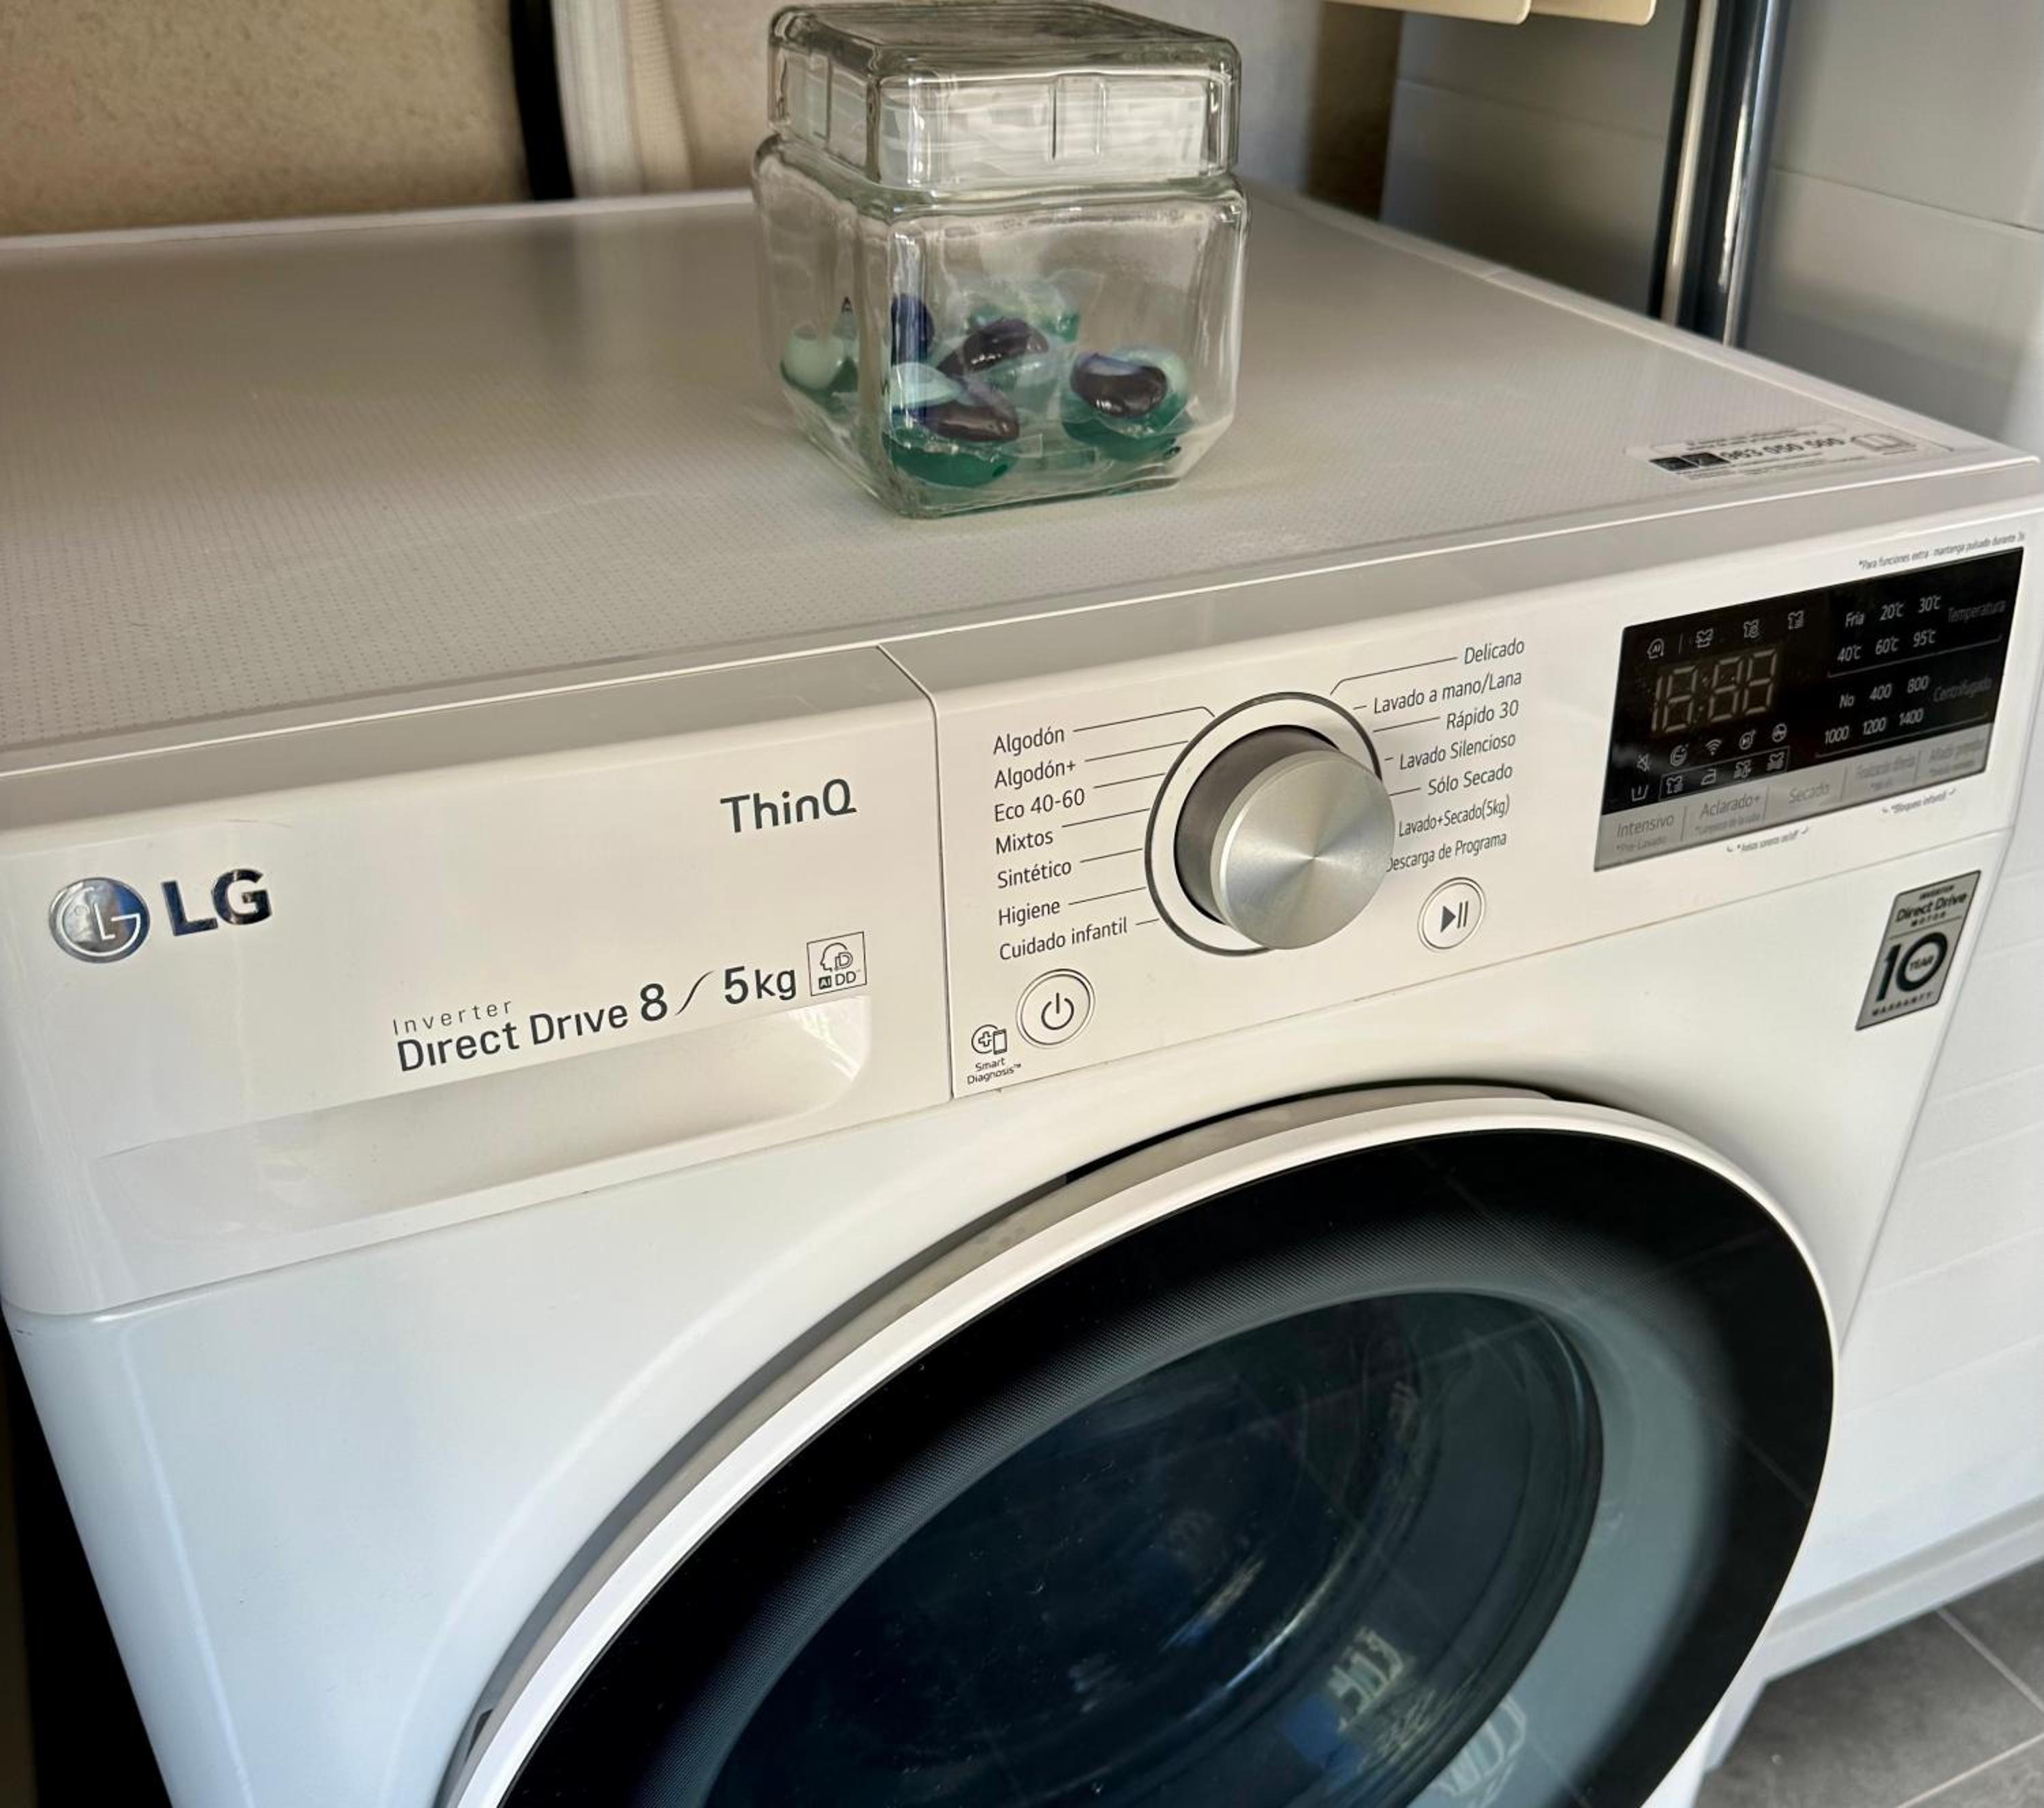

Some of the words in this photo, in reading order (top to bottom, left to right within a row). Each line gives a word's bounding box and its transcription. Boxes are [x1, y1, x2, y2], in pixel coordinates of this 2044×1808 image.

[1947, 599, 2007, 623] Temperatura
[1464, 638, 1524, 665] Delicado
[1374, 689, 1425, 715] Lavado
[1429, 689, 1438, 702] a
[1442, 671, 1521, 700] mano/Lana
[1839, 693, 1855, 709] No
[1869, 683, 1893, 701] 400
[1907, 675, 1930, 694] 800
[1933, 677, 1993, 702] Centrifugado
[1446, 707, 1494, 731] Rápido
[1499, 699, 1519, 719] 30
[1825, 726, 1850, 745] 1000
[1863, 717, 1887, 736] 1200
[1899, 708, 1924, 726] 1400
[993, 726, 1065, 757] Algodón
[1399, 746, 1446, 770] Lavado
[1451, 733, 1516, 760] Silencioso
[994, 759, 1077, 790] Algodón+
[1428, 775, 1458, 796] Sólo
[1464, 764, 1513, 788] Secado
[720, 778, 856, 833] ThinQ
[994, 803, 1024, 822] Eco
[1030, 788, 1085, 814] 40-60
[1788, 782, 1830, 804] Secado
[1399, 794, 1510, 837] Lavado+Secado(5kg)
[1617, 815, 1674, 838] Intensivo
[995, 830, 1054, 855] Mixtos
[1438, 843, 1451, 861] de
[1455, 832, 1506, 858] Programa
[997, 860, 1072, 889] Sintético
[161, 869, 273, 937] LG
[998, 900, 1061, 927] Higiene
[1896, 901, 1932, 922] Direct
[1934, 892, 1968, 911] Drive
[1000, 932, 1066, 961] Cuidado
[1072, 916, 1128, 945] infantil
[1876, 931, 1948, 1002] 10
[1909, 955, 1934, 971] YEAR
[818, 976, 832, 989] AI
[392, 1000, 512, 1035] Inverter
[1872, 991, 1934, 1017] WARRANTY
[397, 1022, 520, 1072] Direct
[529, 1003, 629, 1046] Drive
[975, 1057, 1006, 1072] Smart
